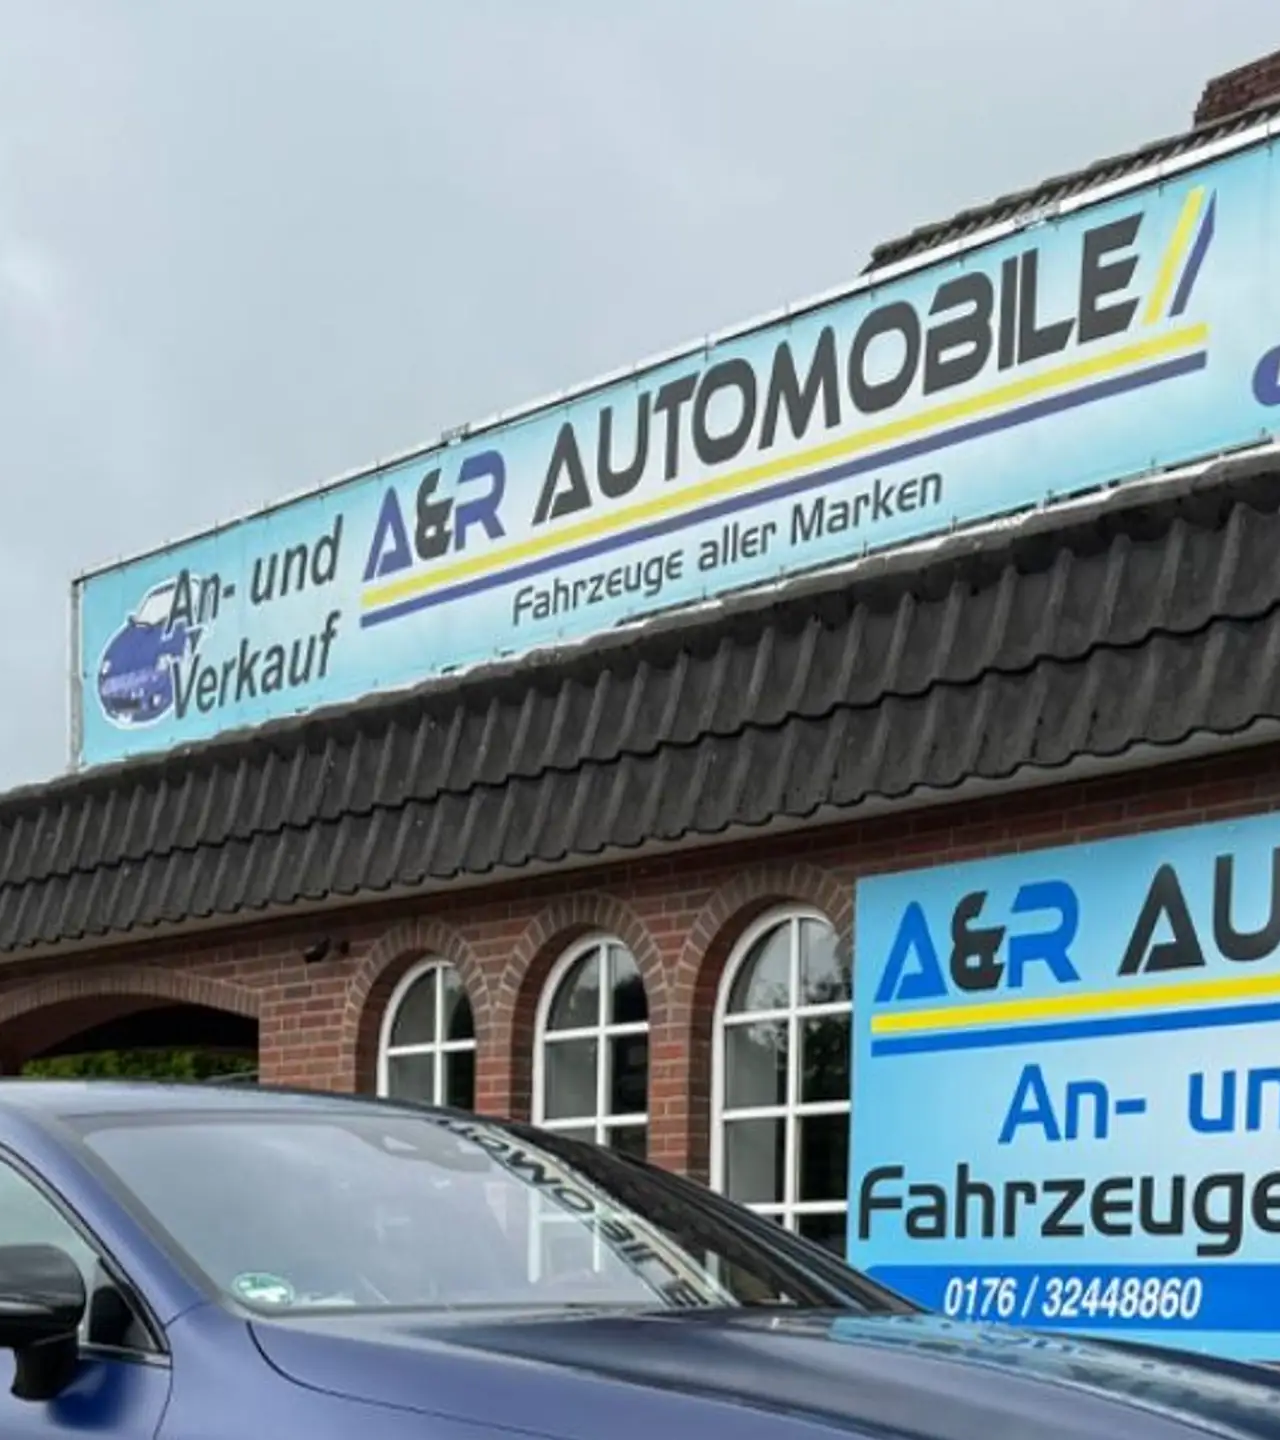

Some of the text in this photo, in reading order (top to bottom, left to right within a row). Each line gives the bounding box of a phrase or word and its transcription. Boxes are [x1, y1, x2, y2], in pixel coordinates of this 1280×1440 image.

[362, 211, 1145, 580] A&R AUTOMOBILE
[166, 515, 344, 632] An- und
[511, 472, 943, 625] Fahrzeuge aller Marken
[169, 610, 340, 720] Verkauf
[873, 880, 1080, 1003] A&R
[998, 1063, 1146, 1144] An-
[944, 1277, 1018, 1317] 0176
[1043, 1277, 1202, 1320] 32448860
